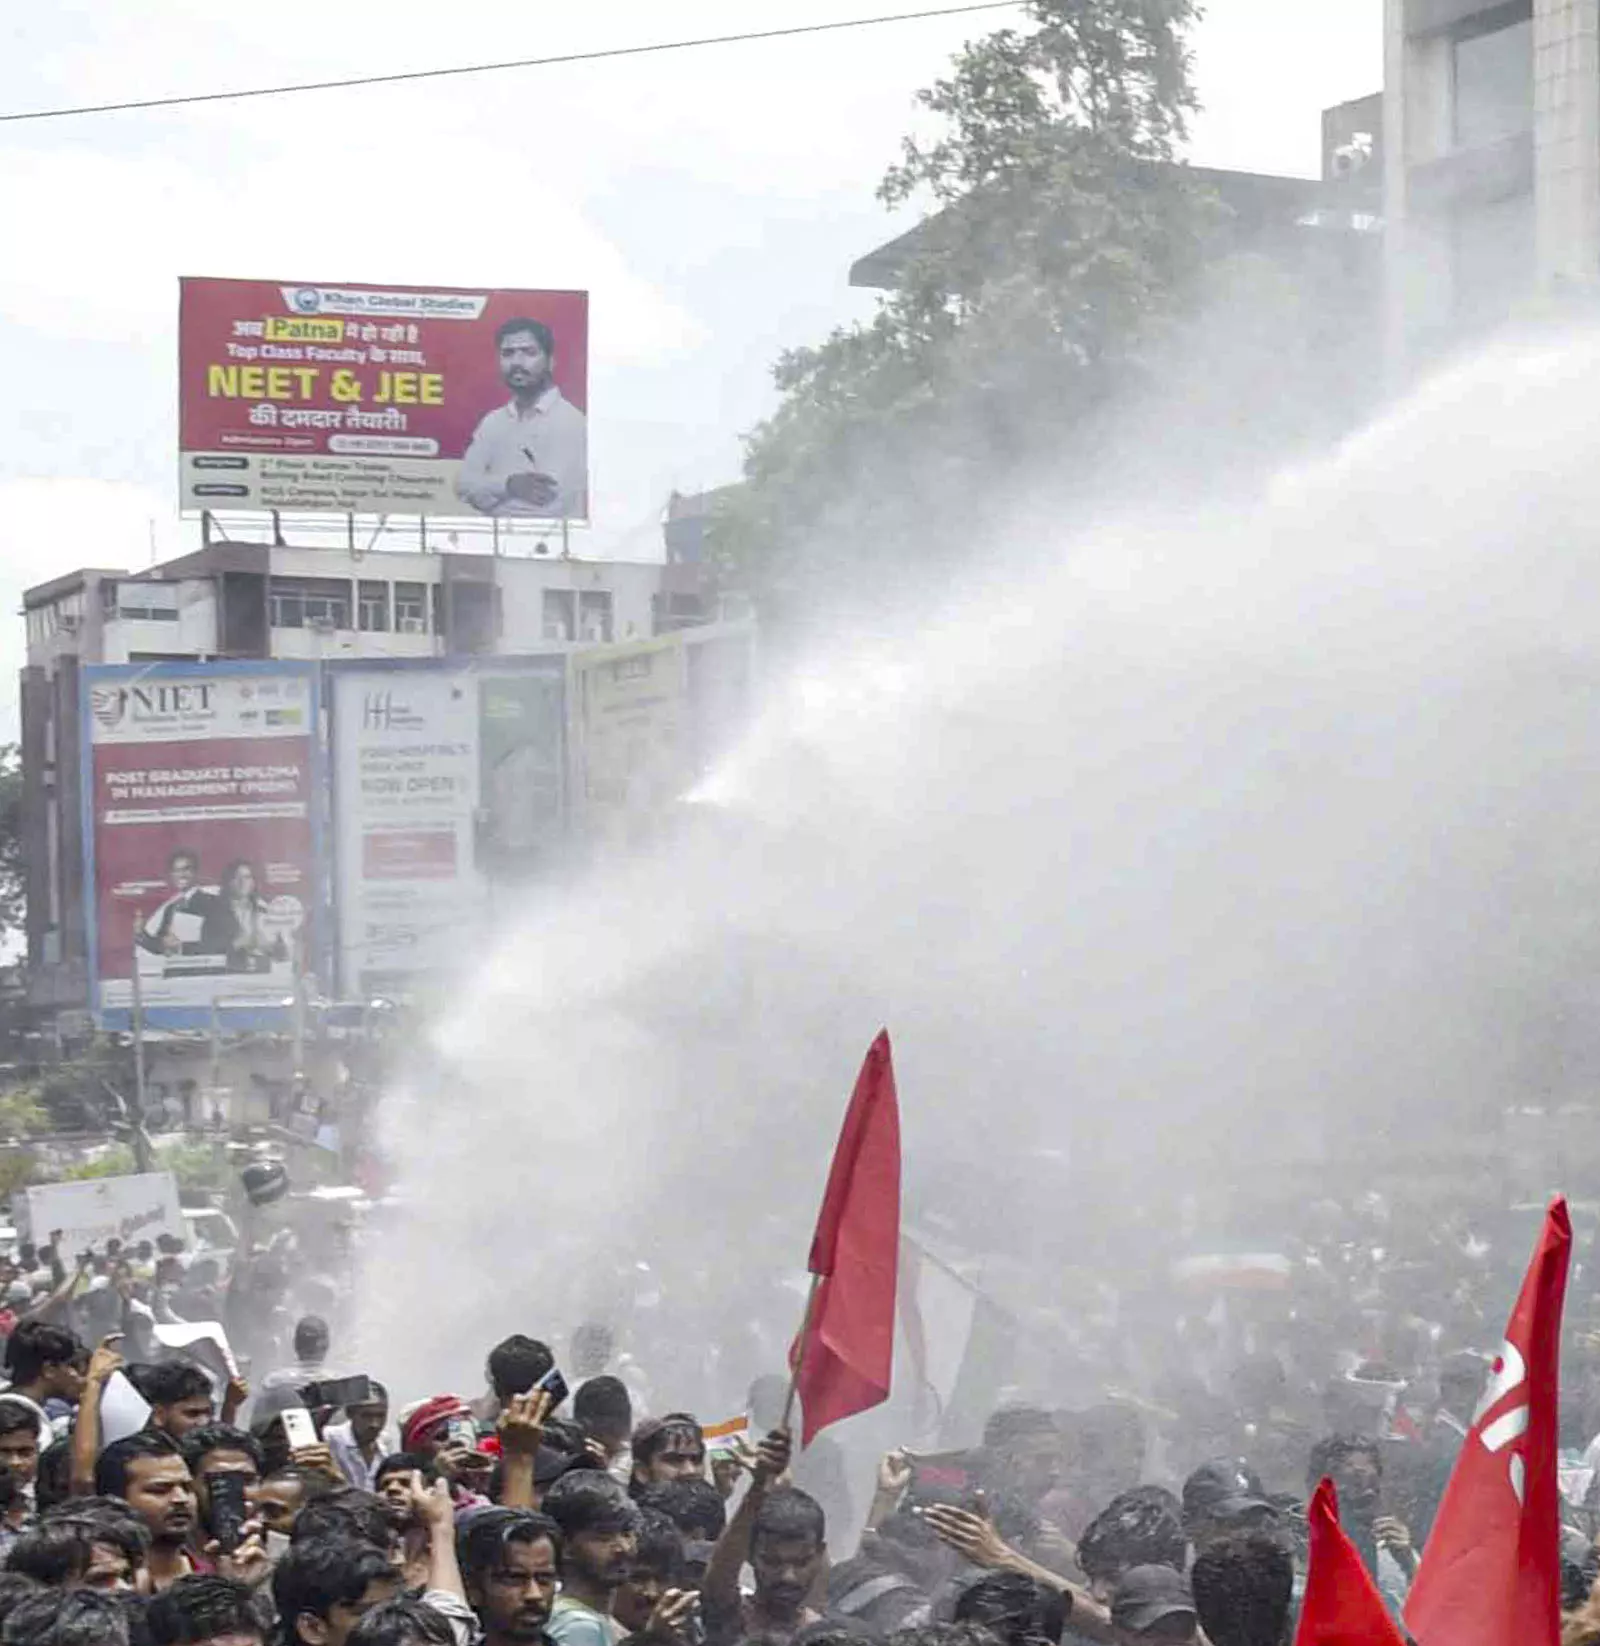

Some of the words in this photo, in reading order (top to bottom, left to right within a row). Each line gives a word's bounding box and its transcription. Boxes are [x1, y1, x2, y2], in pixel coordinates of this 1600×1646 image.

[420, 297, 476, 311] Studies
[273, 319, 339, 341] Patna
[226, 342, 258, 361] Top
[260, 343, 303, 361] Class
[305, 345, 366, 365] Faculty
[208, 364, 319, 400] NEET
[330, 368, 362, 403] &
[374, 371, 445, 405] JEE
[248, 403, 278, 428] की
[280, 408, 343, 430] दमदार
[131, 684, 217, 713] NIET
[105, 771, 147, 785] POST
[149, 767, 231, 783] GRADUATE
[233, 764, 300, 781] DIPLOMA
[406, 775, 457, 792] OPEN
[111, 785, 130, 800] IN
[131, 781, 238, 798] MANAGEMENT
